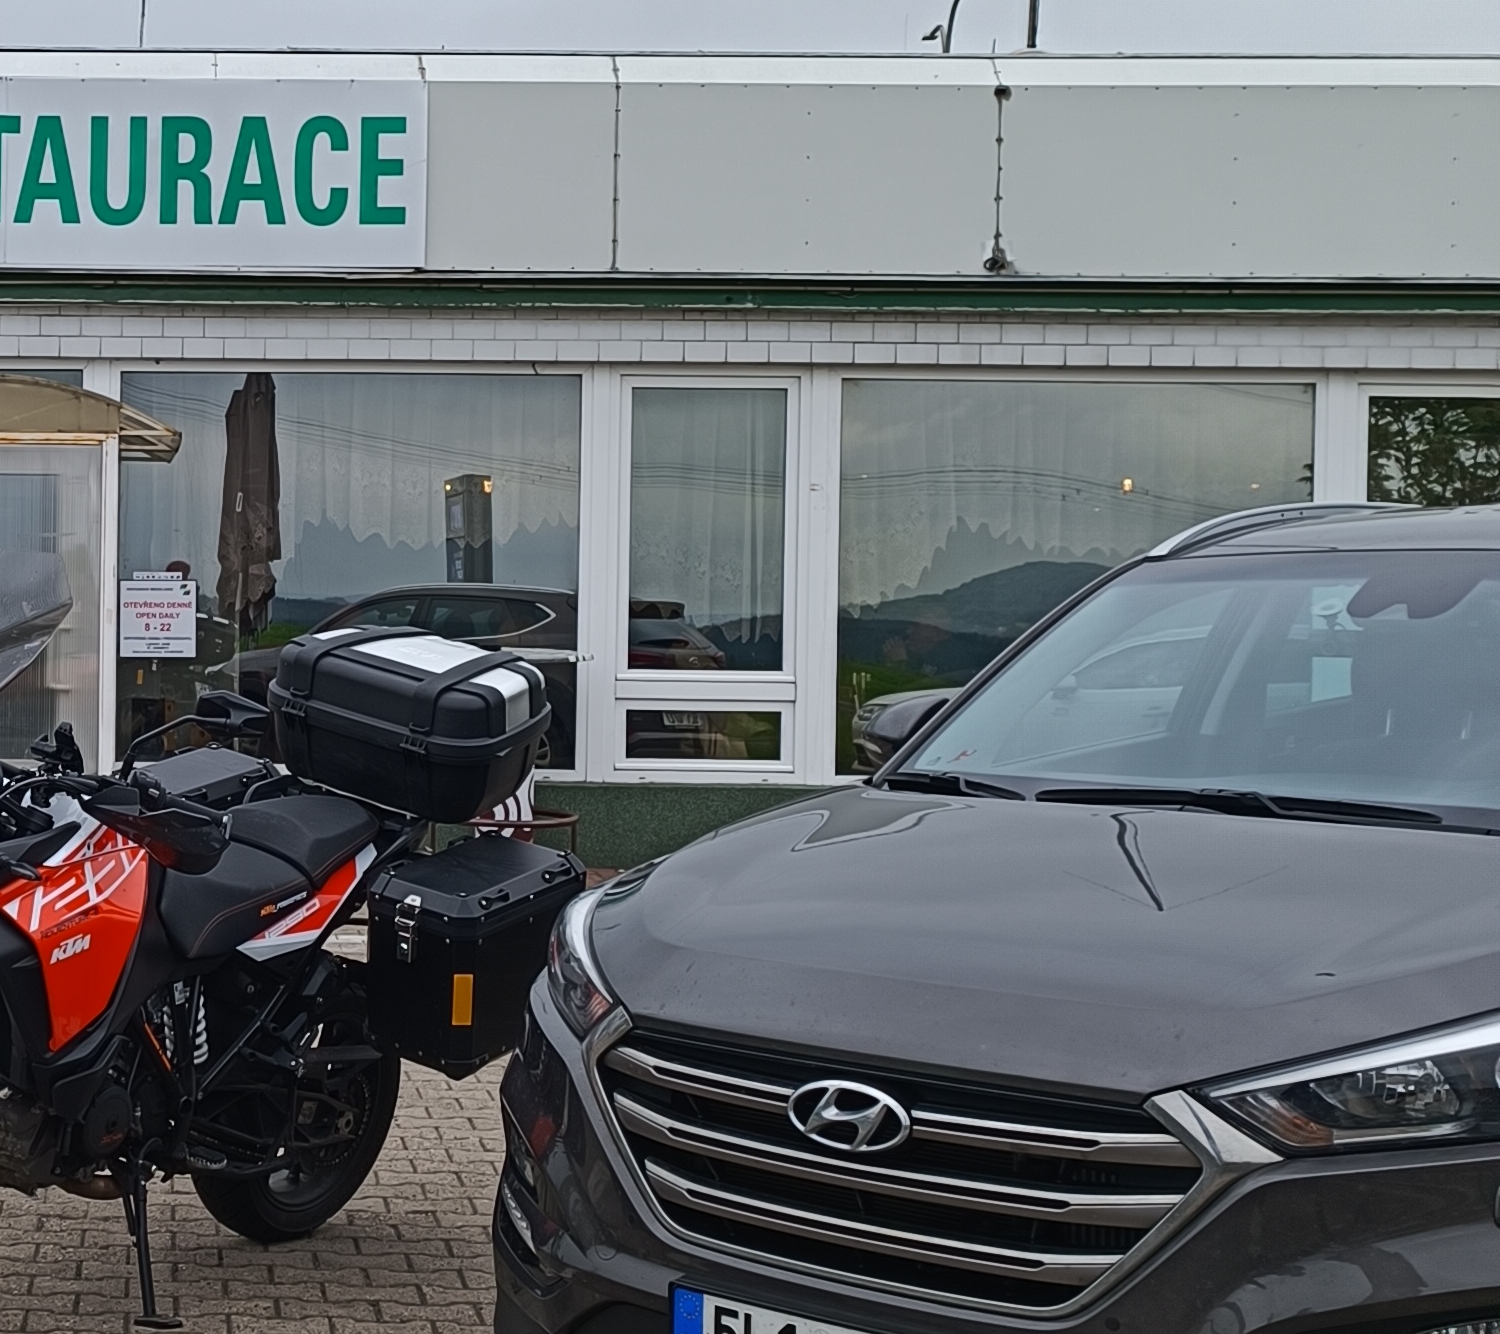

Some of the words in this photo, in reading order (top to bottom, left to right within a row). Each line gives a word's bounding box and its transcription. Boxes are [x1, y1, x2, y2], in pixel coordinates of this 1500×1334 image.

[123, 600, 165, 609] OTEVŘENO
[144, 623, 151, 632] 8
[159, 623, 172, 632] 22
[50, 933, 91, 964] KTM
